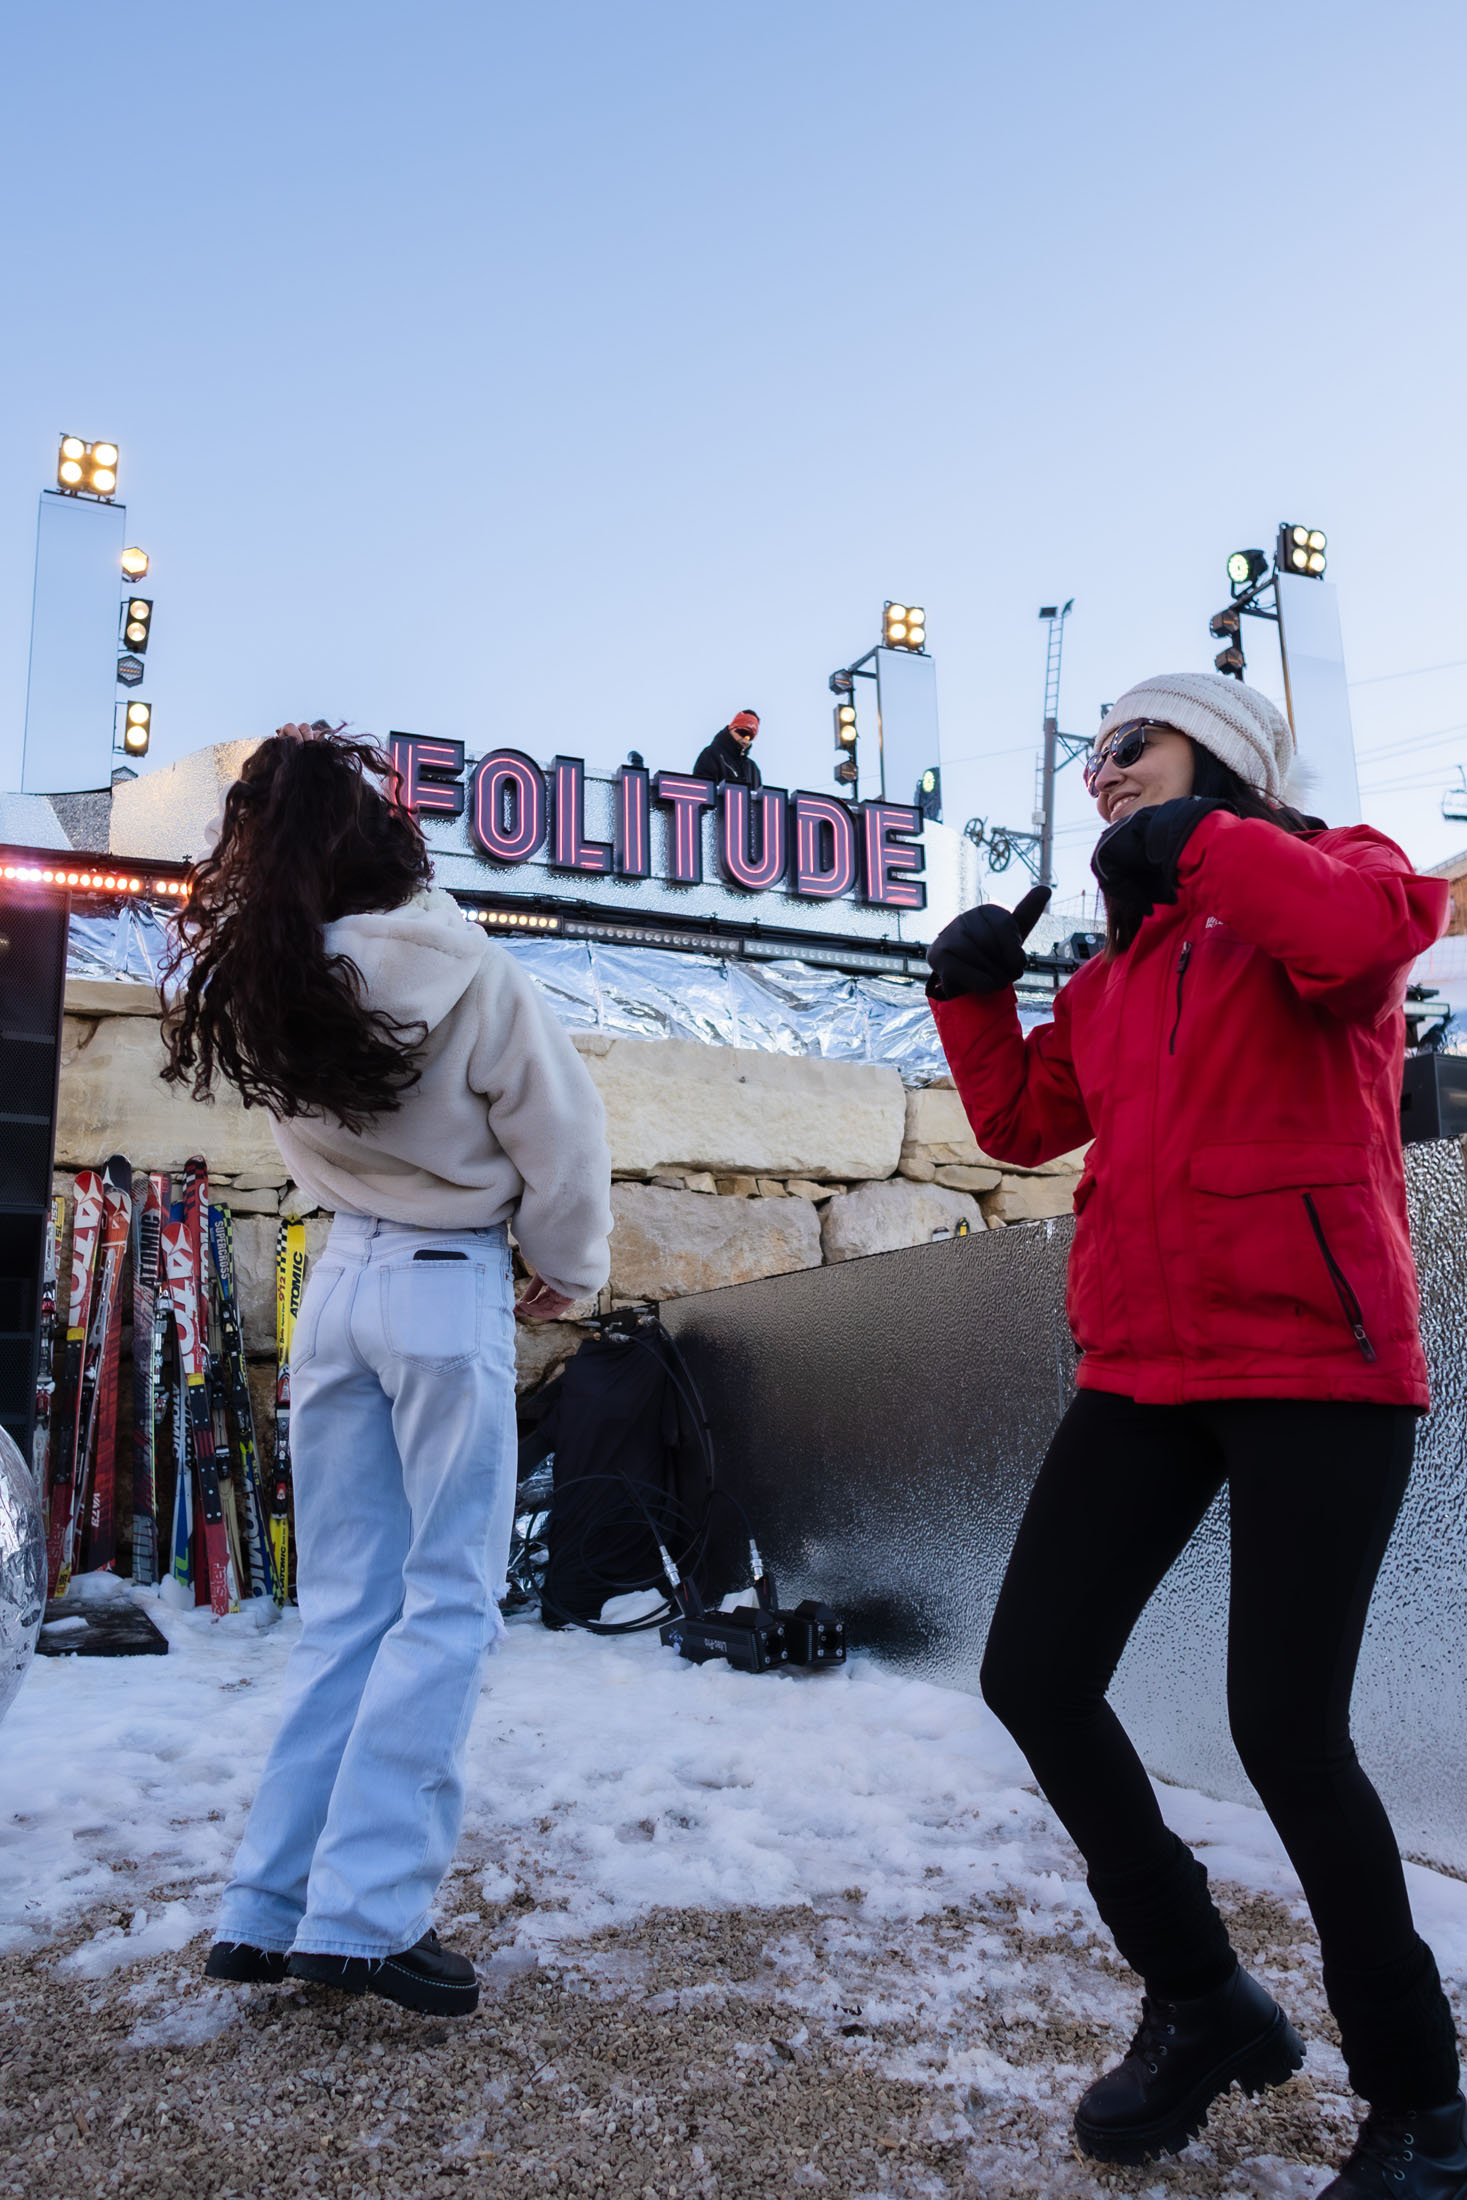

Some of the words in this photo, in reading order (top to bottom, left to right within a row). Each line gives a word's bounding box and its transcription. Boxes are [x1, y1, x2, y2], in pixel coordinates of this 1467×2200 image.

[139, 1214, 160, 1288] ATOMIC
[214, 1220, 231, 1280] SUPERCROSS
[289, 1250, 303, 1319] ATOMIC
